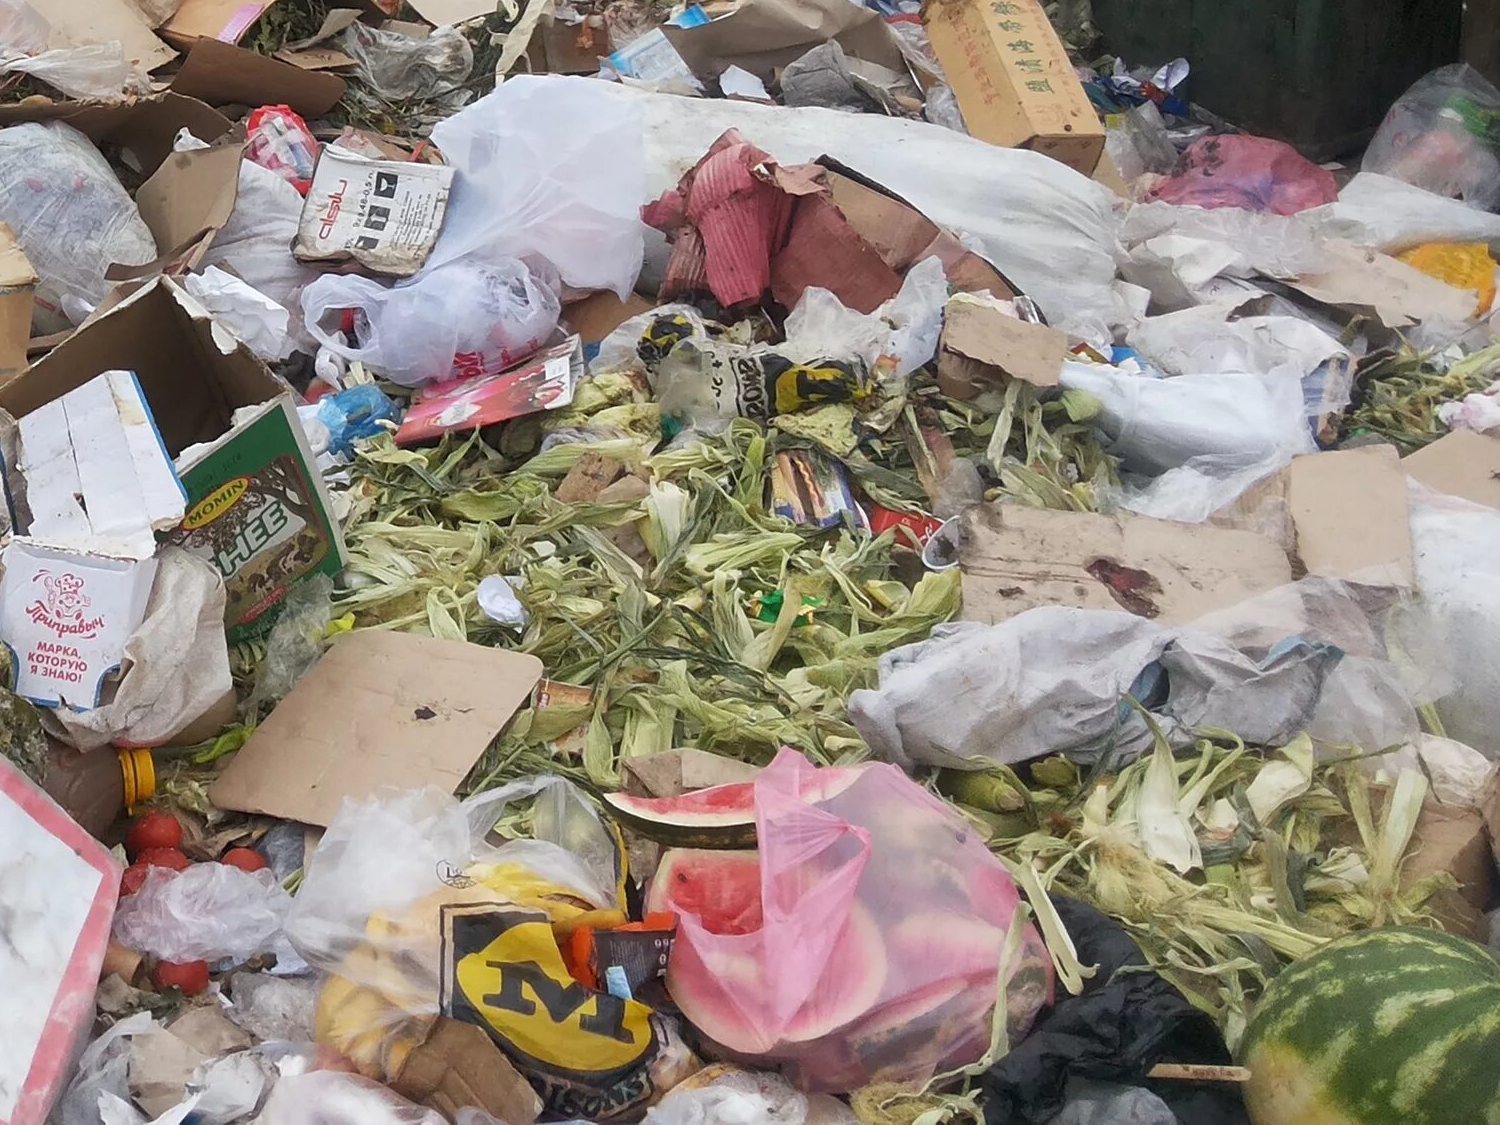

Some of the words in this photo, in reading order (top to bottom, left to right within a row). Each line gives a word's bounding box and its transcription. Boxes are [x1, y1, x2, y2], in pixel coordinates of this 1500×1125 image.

[188, 479, 244, 526] MOMIN
[217, 499, 288, 577] HEE
[26, 600, 104, 638] Приправыч
[27, 652, 88, 672] КОТОРУЮ
[37, 641, 81, 659] МАРКА,
[30, 665, 38, 675] Я
[41, 666, 82, 683] ЗНАЮ!
[483, 960, 635, 1044] M
